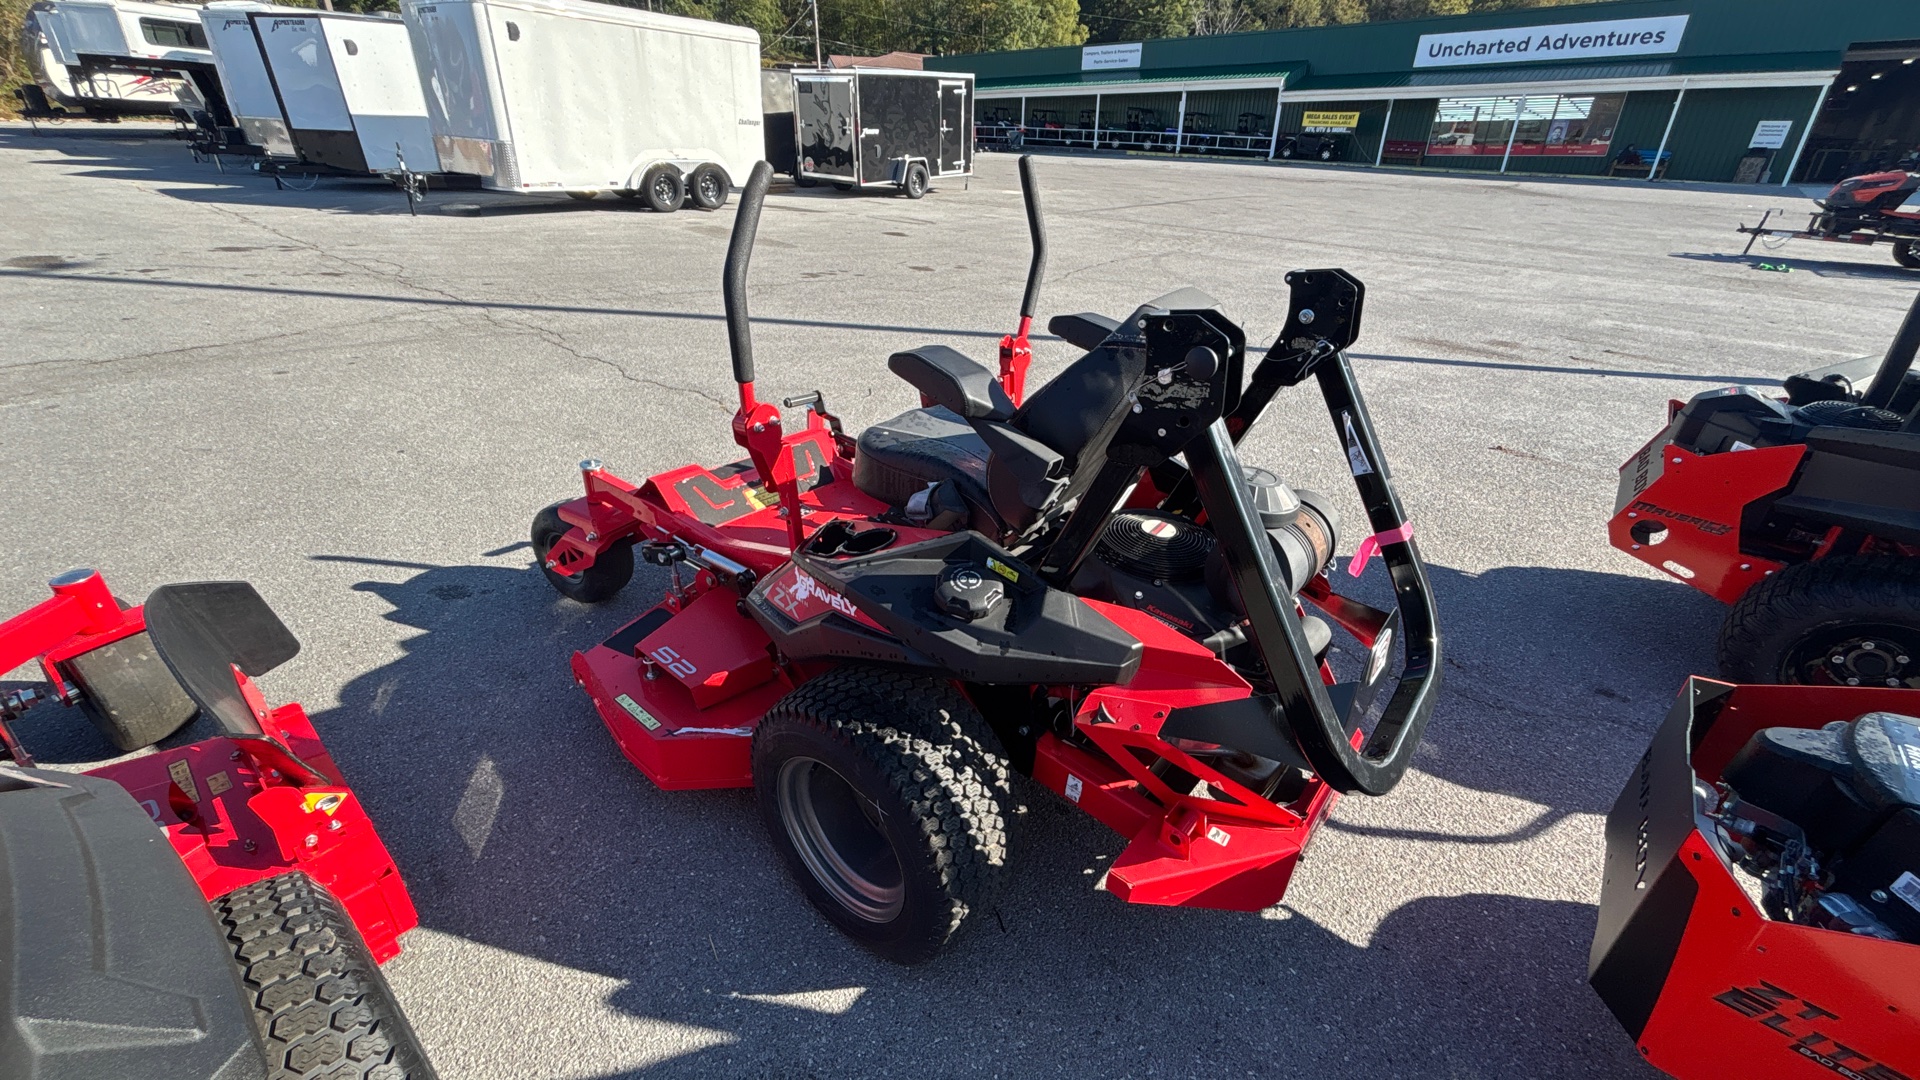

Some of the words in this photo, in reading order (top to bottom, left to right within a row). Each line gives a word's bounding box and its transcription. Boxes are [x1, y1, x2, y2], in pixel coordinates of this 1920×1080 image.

[1429, 36, 1531, 58] Uncharted
[1535, 30, 1666, 52] Adventures
[773, 586, 799, 620] ZX
[799, 574, 858, 617] GRAVELY
[1146, 604, 1194, 629] Kawasaki
[650, 646, 697, 679] 52
[1744, 979, 1841, 1021] ZT
[1799, 1047, 1834, 1067] BAD
